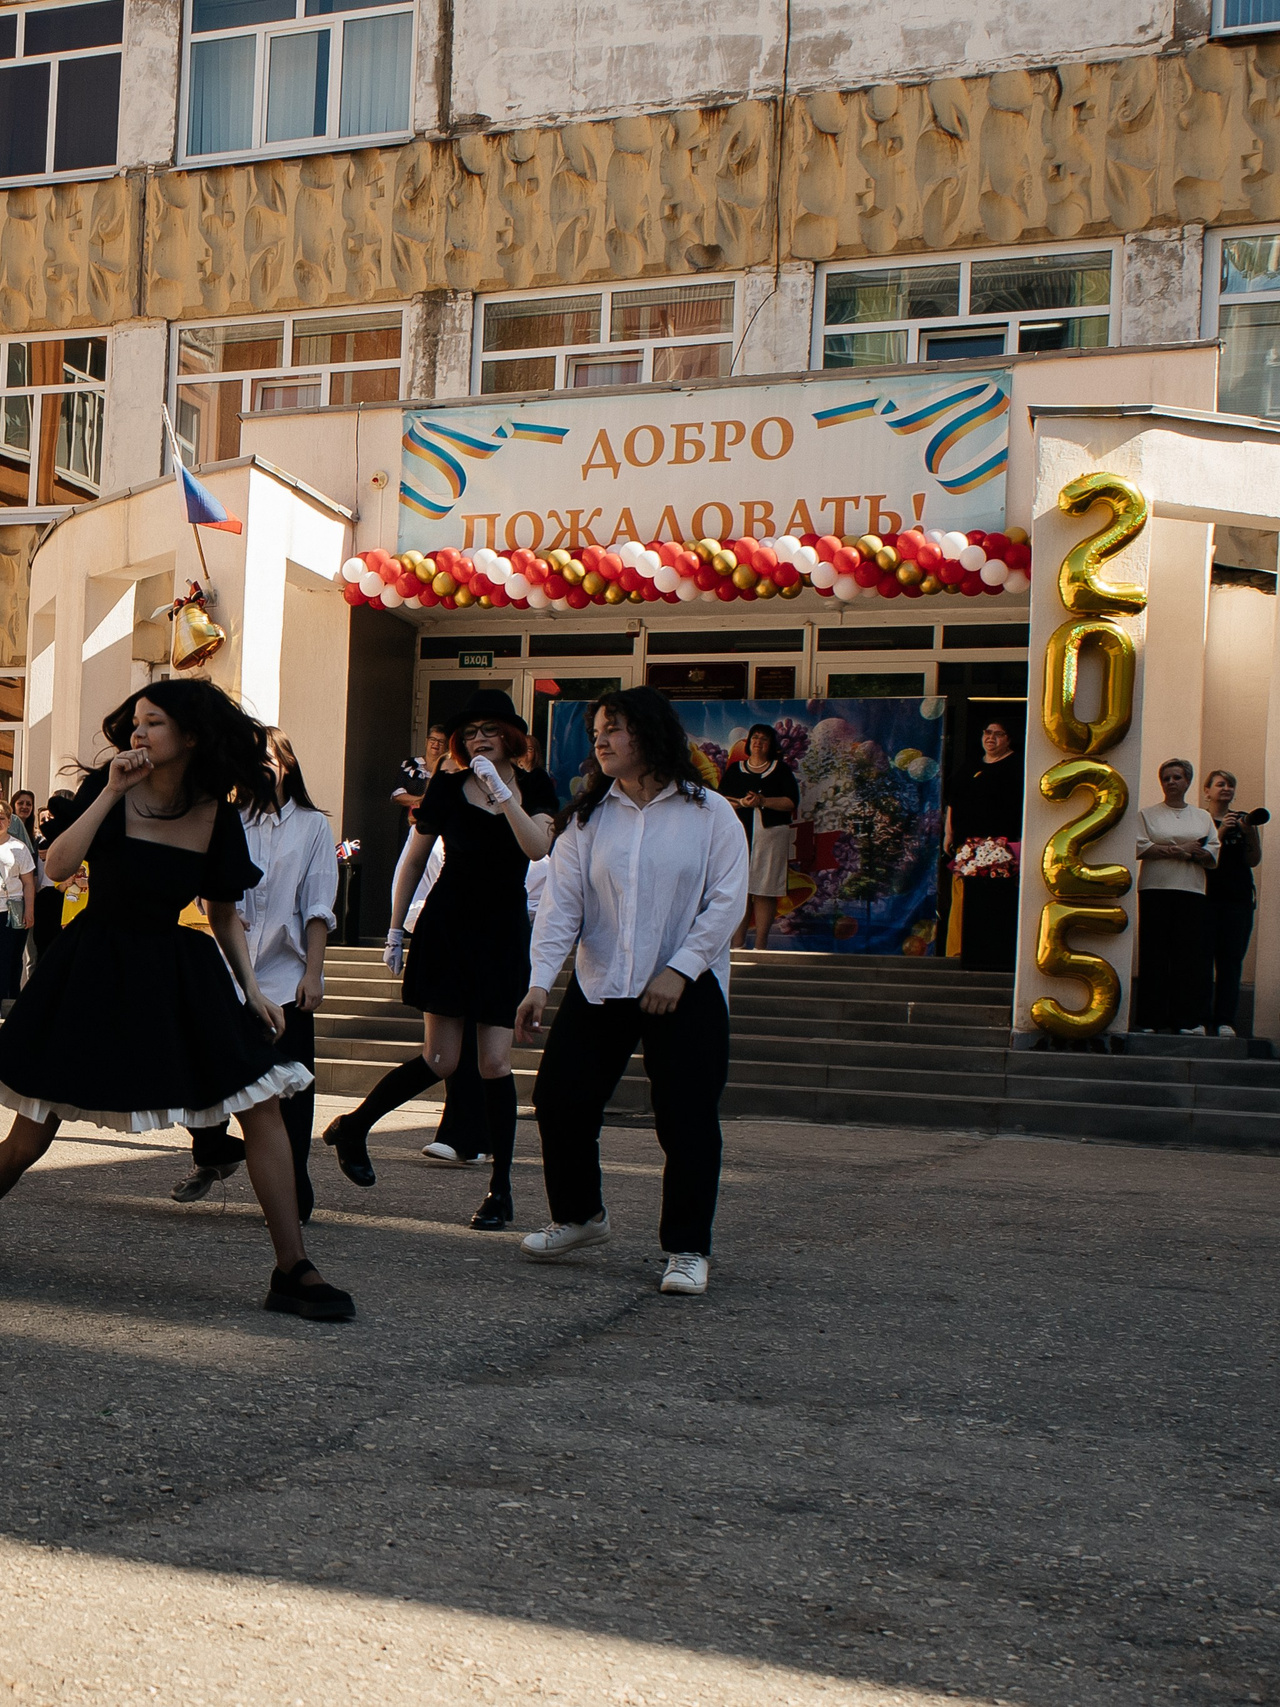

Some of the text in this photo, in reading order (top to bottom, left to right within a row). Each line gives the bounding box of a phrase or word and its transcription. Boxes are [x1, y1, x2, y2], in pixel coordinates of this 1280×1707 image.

[581, 416, 795, 481] ДОБРО
[461, 493, 926, 553] ПОЖАЛОВАТЬ!
[464, 655, 488, 667] ВХОД
[1031, 472, 1148, 1039] 2025
